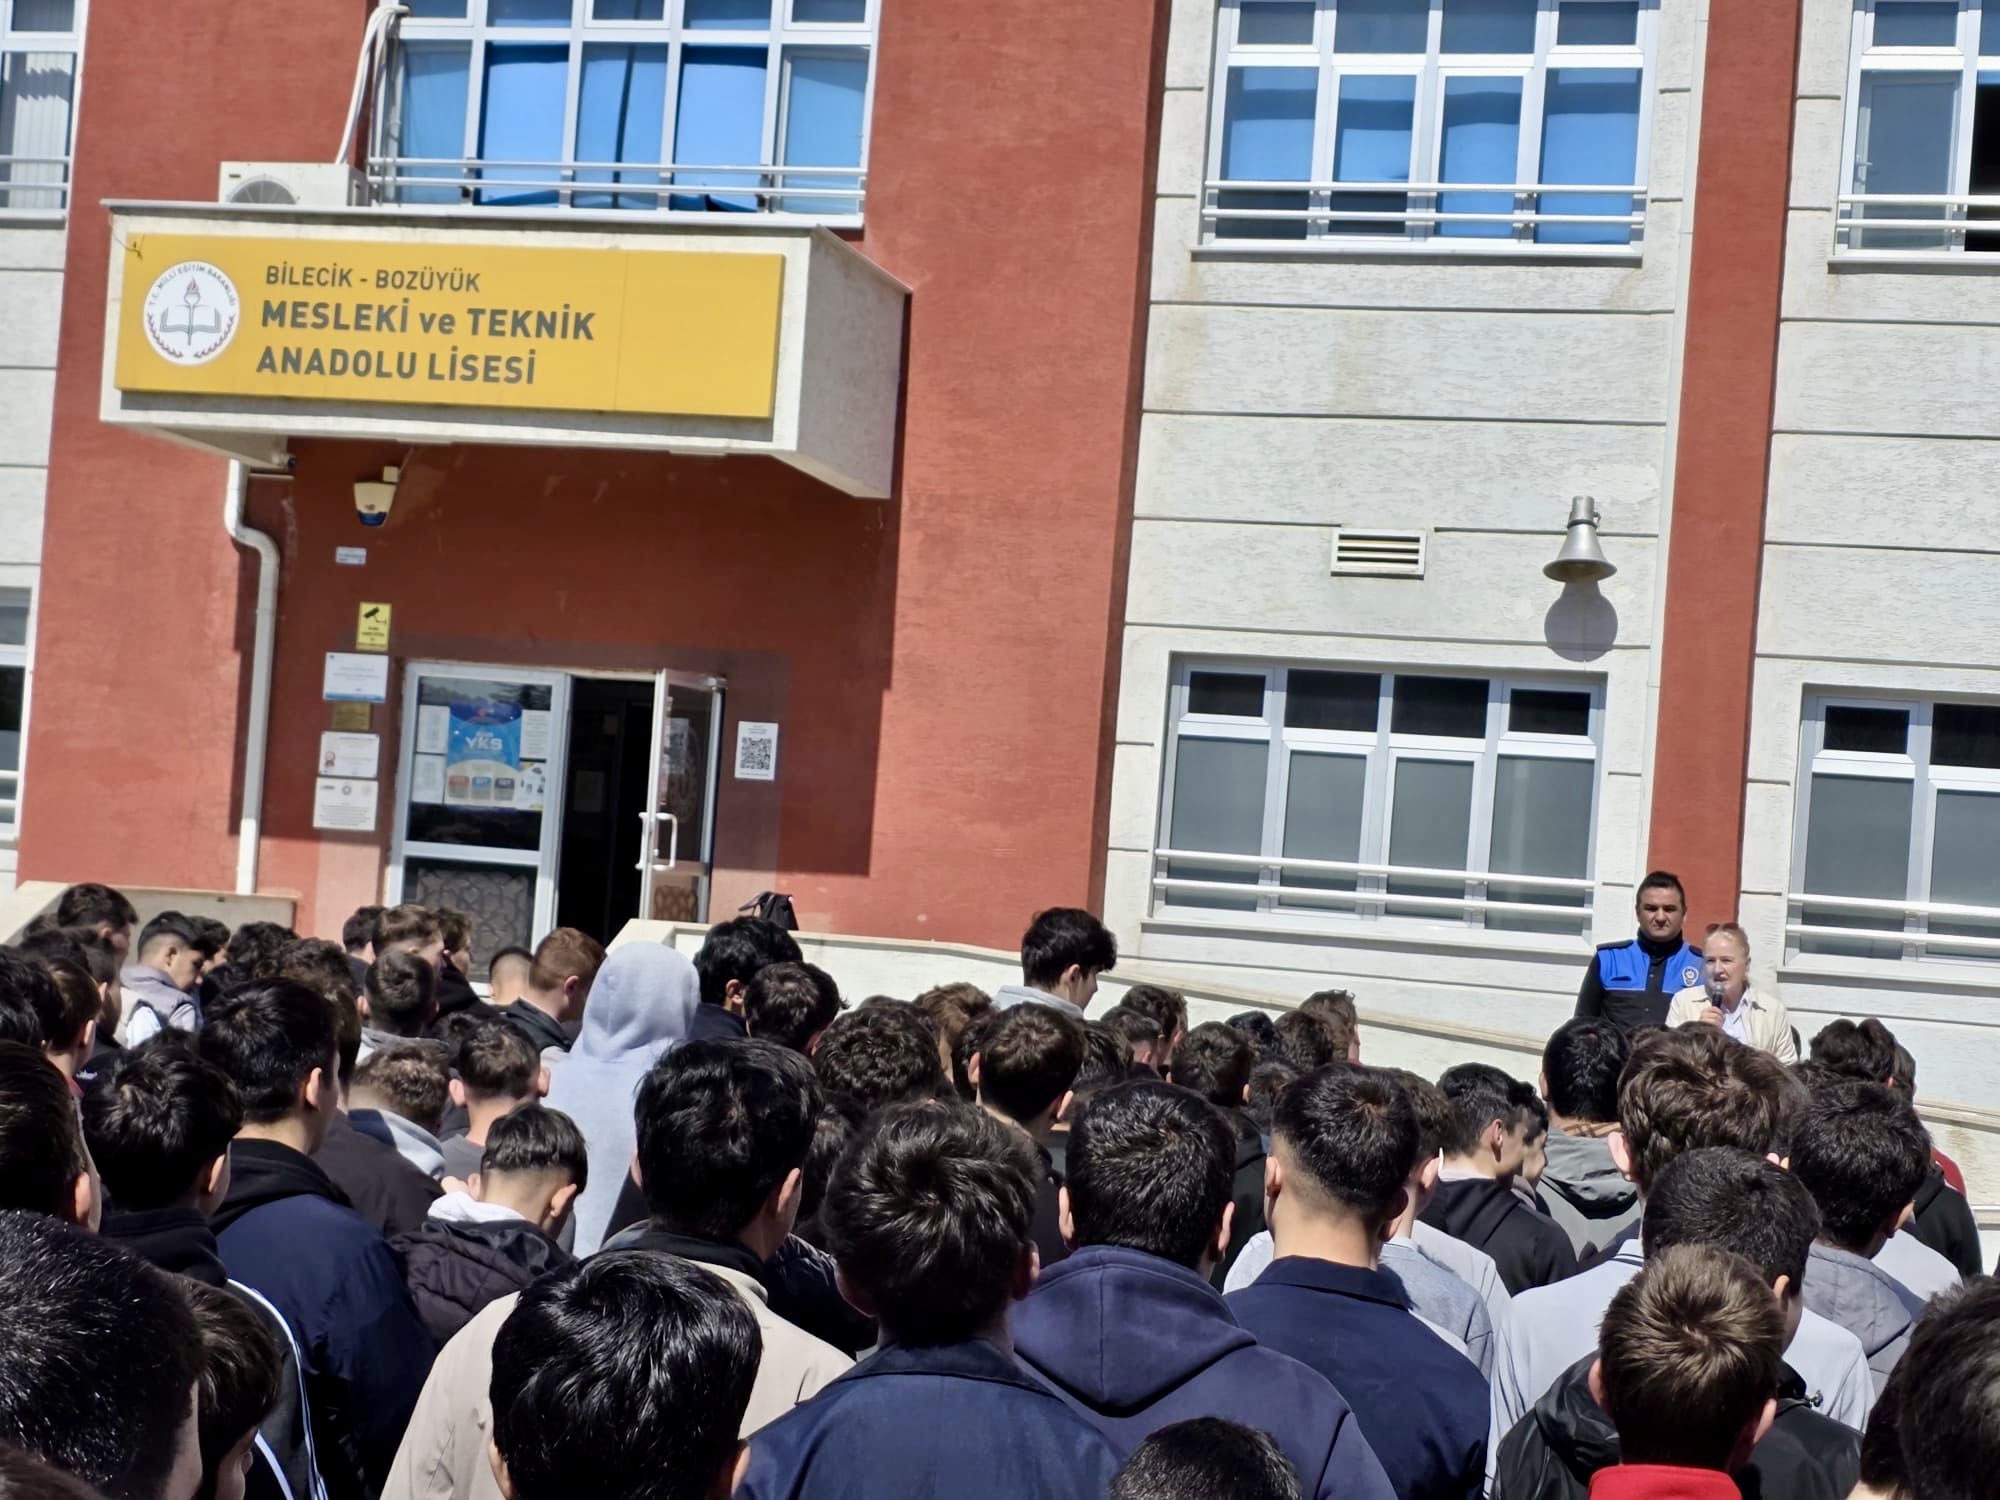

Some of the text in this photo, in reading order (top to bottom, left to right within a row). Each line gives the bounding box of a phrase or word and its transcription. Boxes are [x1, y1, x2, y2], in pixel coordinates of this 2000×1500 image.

[265, 261, 353, 288] BİLECİK
[375, 266, 481, 292] BOZÜYÜK
[262, 298, 597, 341] MESLEKİ ve TEKNİK
[256, 345, 535, 385] ANADOLU LİSESİ
